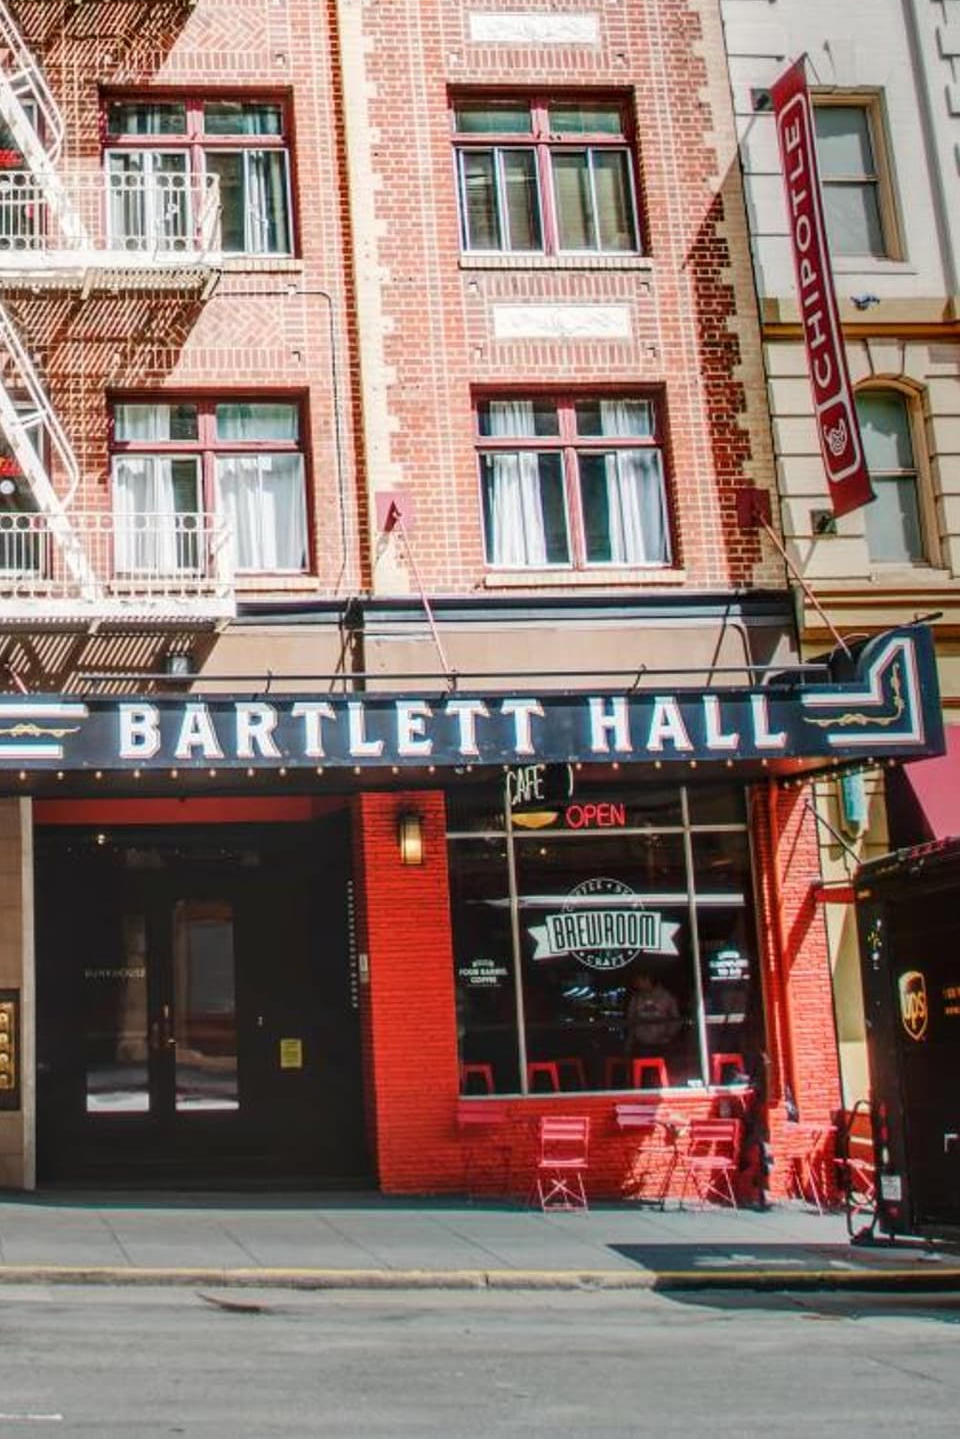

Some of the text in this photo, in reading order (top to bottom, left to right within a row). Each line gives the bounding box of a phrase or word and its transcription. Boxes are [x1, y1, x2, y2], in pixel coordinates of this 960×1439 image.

[785, 118, 831, 388] CHIPOTLE
[119, 694, 788, 760] BARTLETT HALL
[506, 764, 545, 805] CAFE
[566, 804, 626, 828] OPEN
[552, 913, 656, 949] BREWROOM
[905, 991, 925, 1030] ups
